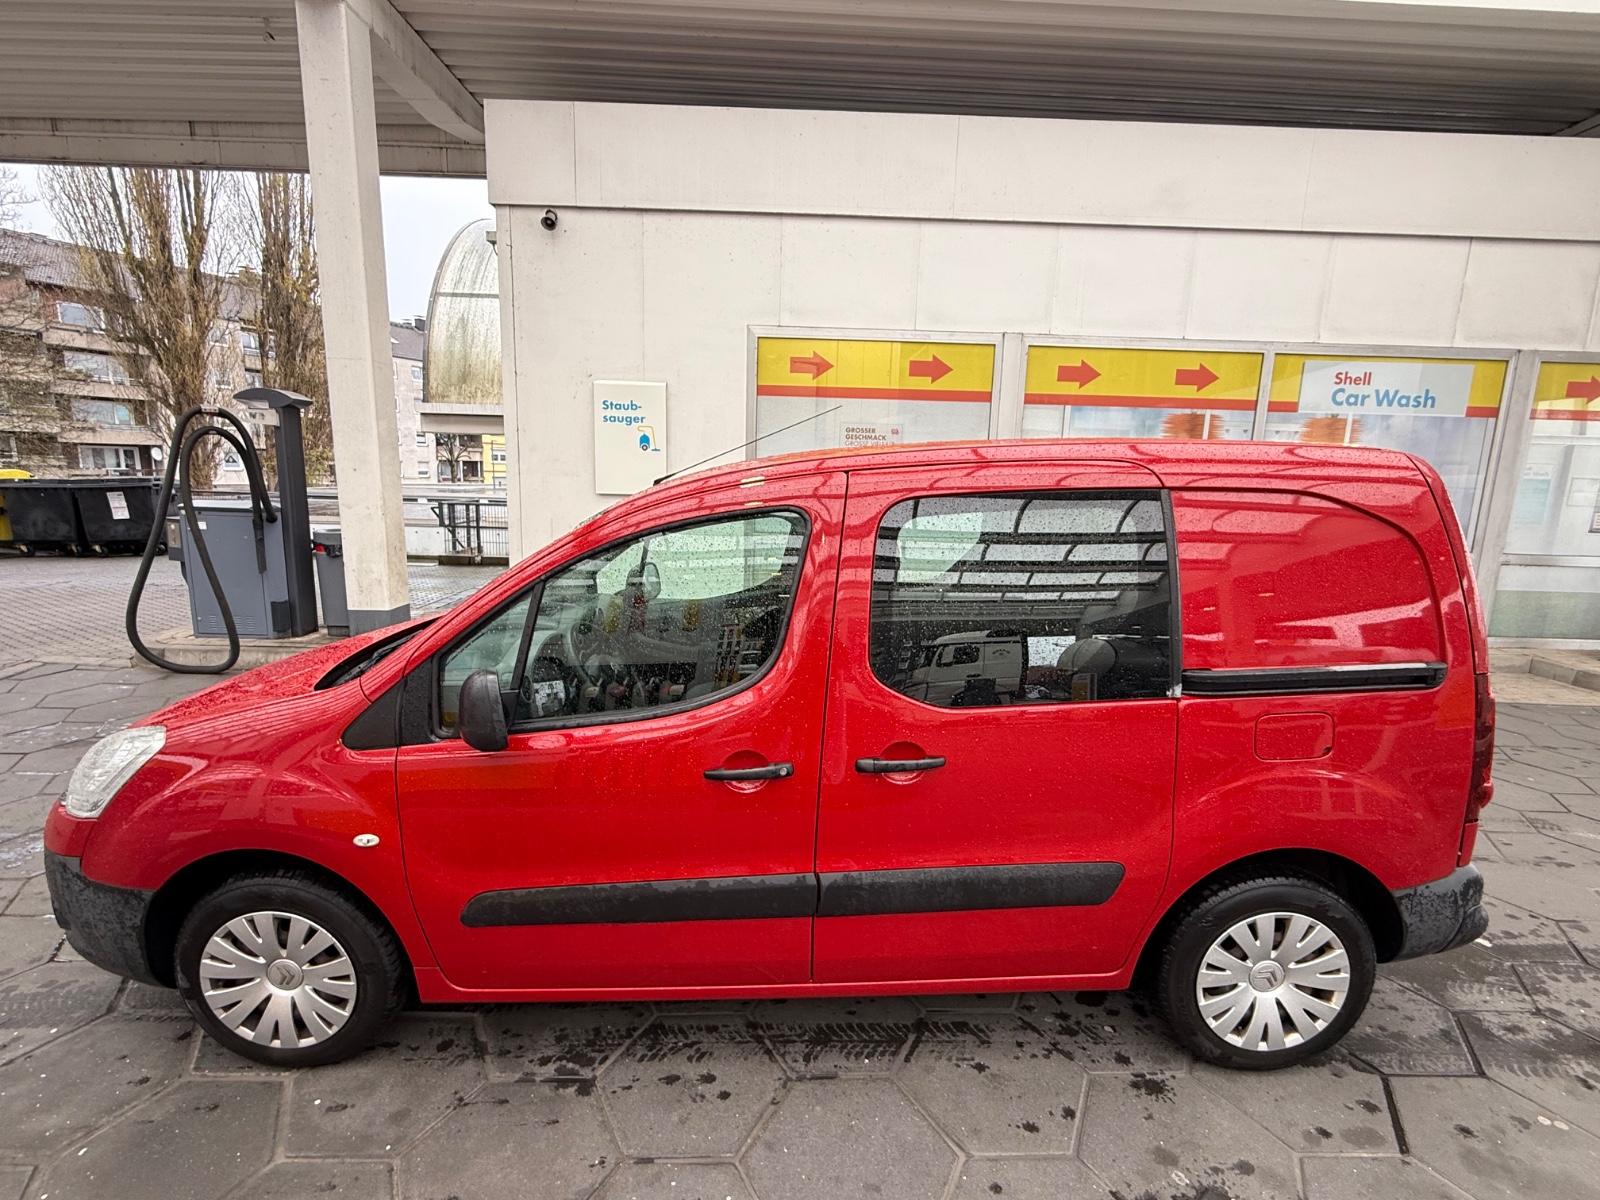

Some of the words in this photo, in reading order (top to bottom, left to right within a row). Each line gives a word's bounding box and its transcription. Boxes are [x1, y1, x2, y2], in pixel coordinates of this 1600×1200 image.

[1334, 371, 1372, 386] Shell
[1331, 387, 1370, 407] Car
[1374, 388, 1436, 409] Wash
[602, 399, 642, 411] Staub-
[602, 415, 646, 426] sauger
[845, 426, 876, 434] GROSSER
[845, 433, 887, 441] GESCHMACK
